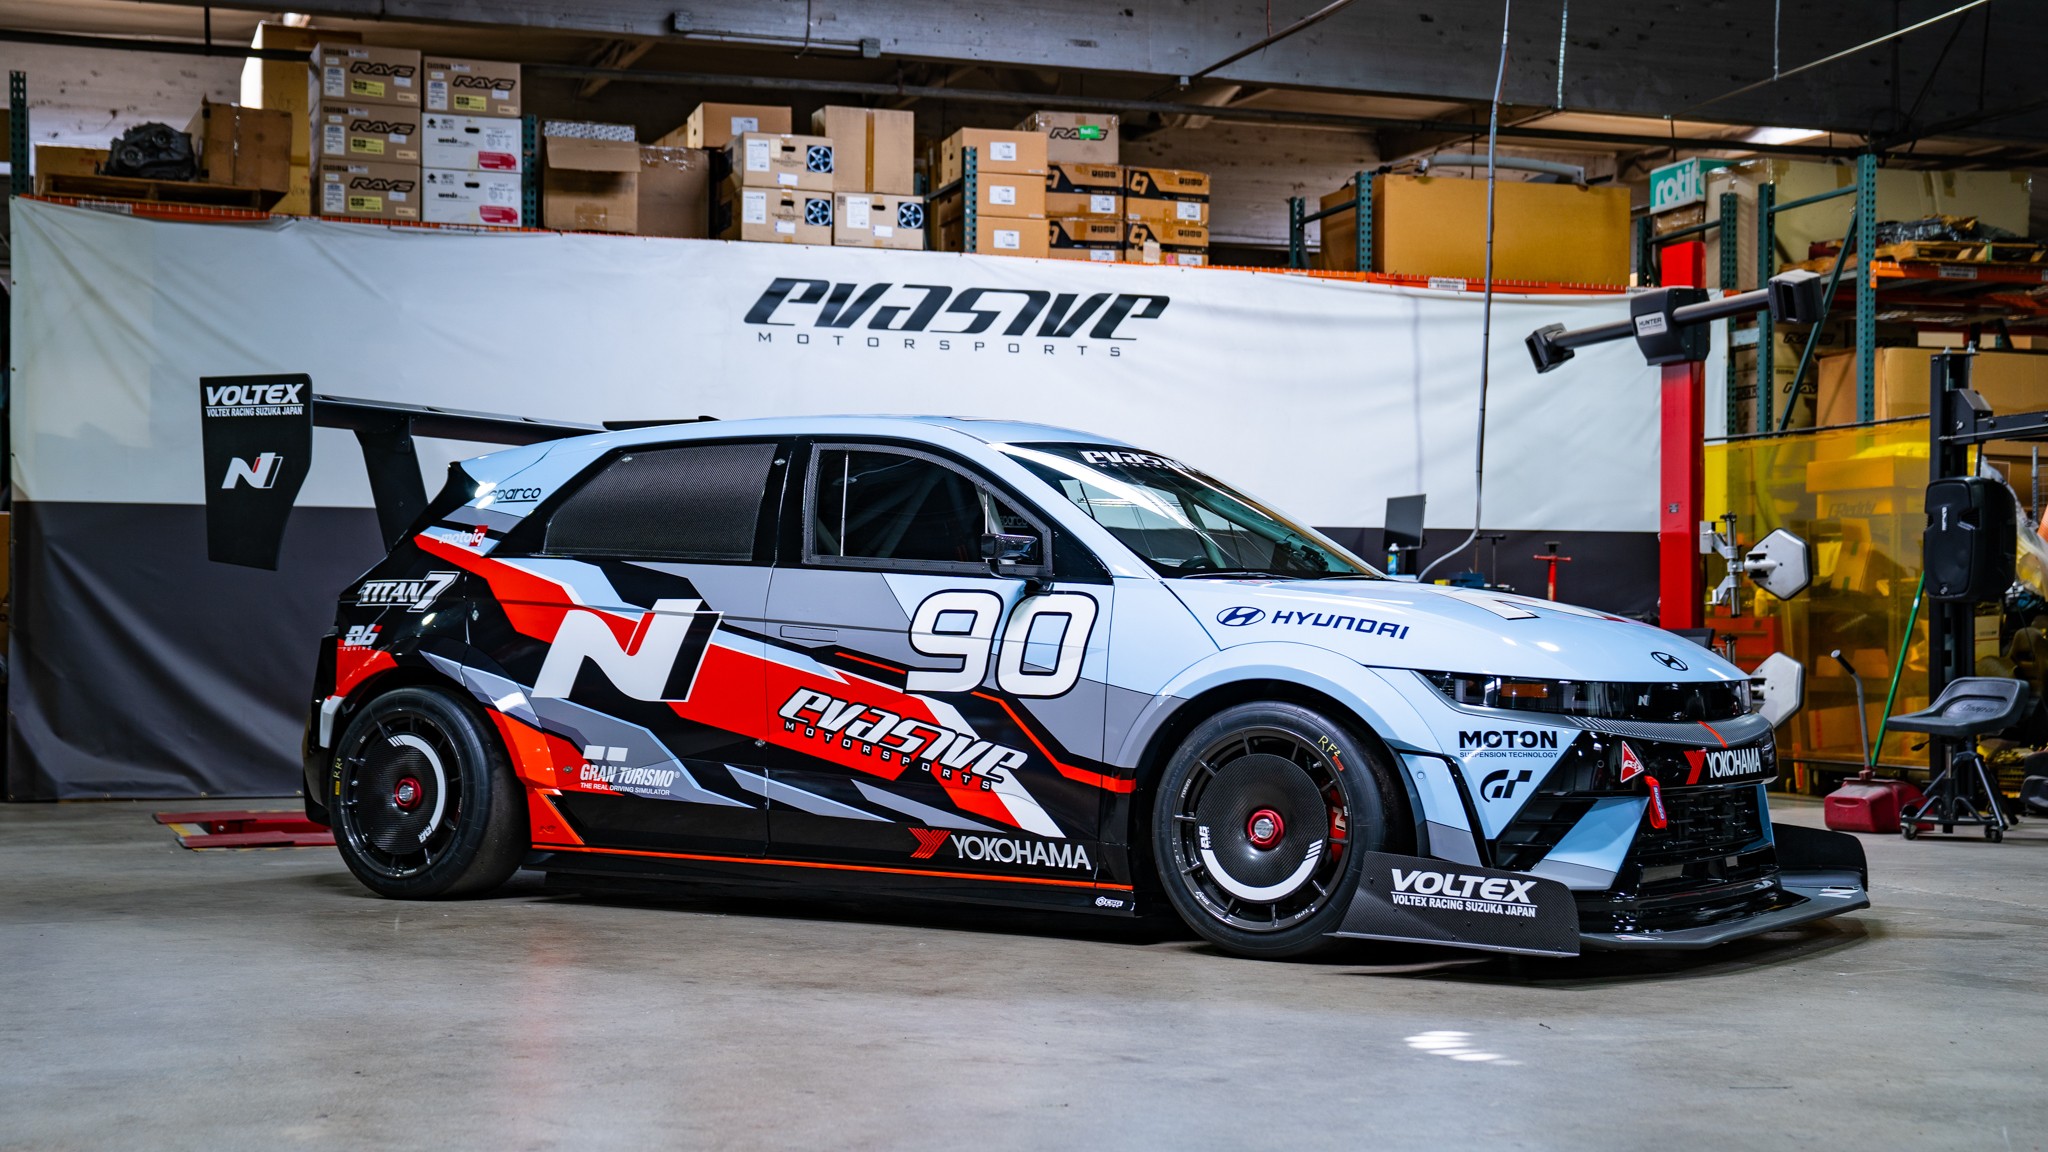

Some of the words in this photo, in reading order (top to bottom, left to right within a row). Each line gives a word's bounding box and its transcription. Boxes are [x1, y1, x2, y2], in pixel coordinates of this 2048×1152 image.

[350, 61, 415, 78] RAYS
[453, 75, 516, 91] RAYS
[350, 119, 415, 135] RAYS
[1049, 127, 1108, 141] RAS
[350, 177, 415, 193] RAYS
[743, 277, 1170, 341] evasive
[758, 332, 1121, 358] MOTORSPORTS
[206, 384, 304, 406] VOLTEX
[207, 408, 231, 417] VOLTEX
[231, 407, 255, 417] RACING
[255, 406, 281, 416] SUZUKA
[282, 406, 303, 416] JAPAN
[221, 452, 284, 489] N
[1271, 610, 1409, 640] HYUNDAI
[531, 599, 724, 702] N
[903, 588, 1100, 699] 90
[777, 686, 1028, 782] evasive
[1459, 730, 1558, 748] MOTON
[784, 720, 994, 791] MOTORSPORTS
[1706, 747, 1762, 779] YOKOHAMA
[580, 763, 618, 783] GRAN
[593, 783, 609, 791] REAL
[609, 784, 634, 793] DRIVING
[635, 786, 671, 796] SIMULATOR
[950, 834, 1092, 870] YOKOHAMA
[1391, 868, 1538, 904] VOLTEX
[1392, 894, 1428, 907] VOLTEX
[1429, 898, 1464, 911] RACING
[1465, 901, 1504, 914] SUZUKA
[1505, 905, 1536, 918] JAPAN
